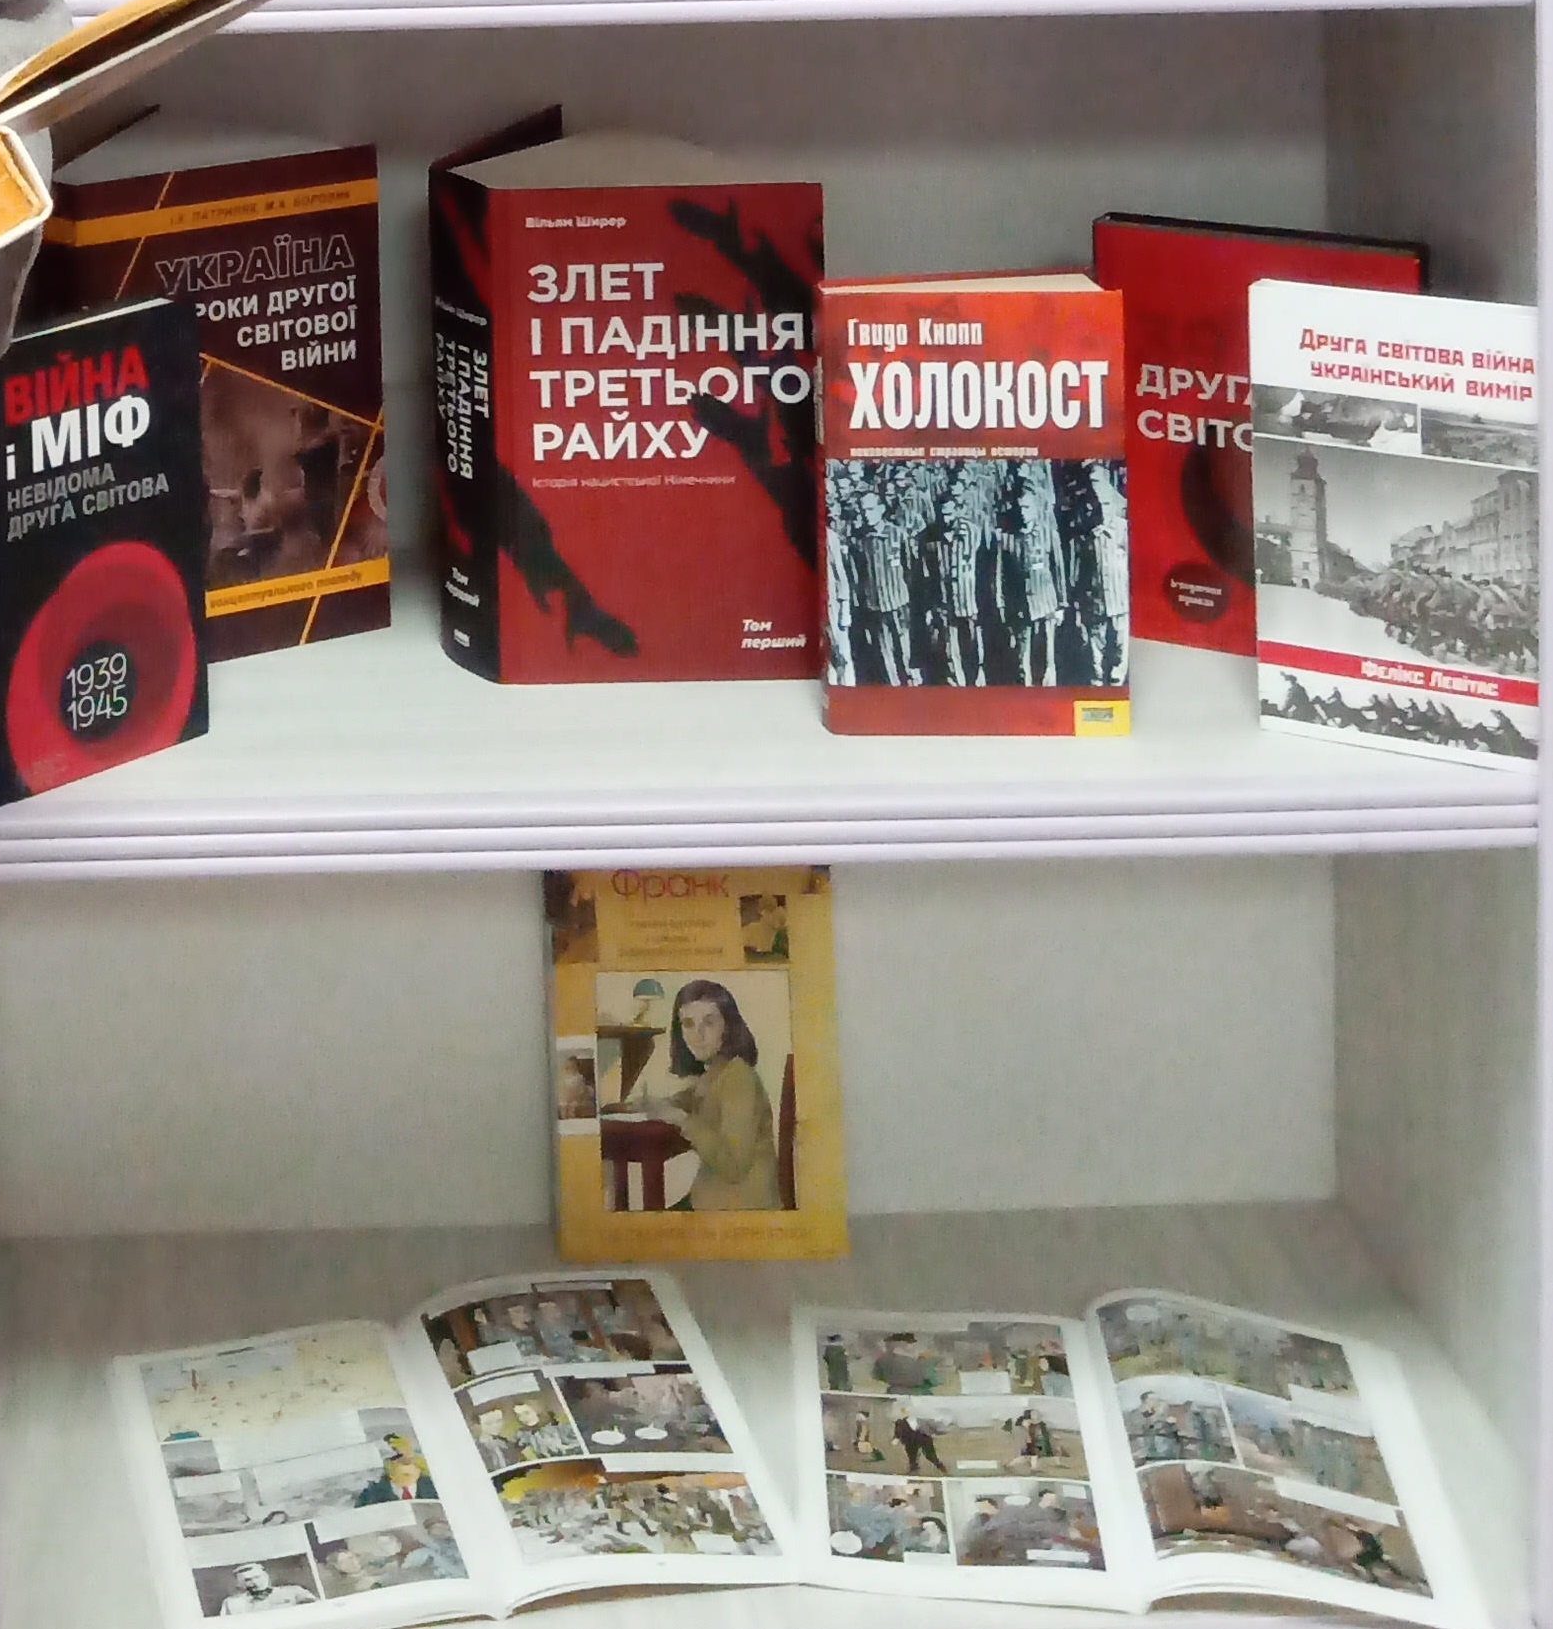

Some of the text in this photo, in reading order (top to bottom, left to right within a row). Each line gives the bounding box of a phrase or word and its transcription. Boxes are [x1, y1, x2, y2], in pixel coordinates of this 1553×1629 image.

[155, 233, 354, 295] УКРАЇНА
[527, 262, 664, 303] ЗЛЕТ
[267, 275, 356, 316] ДРУГОЇ
[237, 306, 357, 347] СВІТОВОЇ
[530, 312, 805, 360] І ПАДІННЯ
[848, 318, 983, 352] Гвидо Кнопп
[281, 340, 356, 371] ВІЙНИ
[4, 345, 149, 426] ВІЙНА
[473, 348, 489, 418] ЗЛЕТ
[529, 366, 811, 408] ТРЕТЬОГО
[848, 360, 1109, 430] ХОЛОКОСТ
[6, 394, 150, 481] і МІФ
[532, 412, 709, 461] РАЙХУ
[7, 463, 116, 512] НЕВІДОМА
[7, 473, 169, 542] ДРУГА СВІТОВА
[741, 634, 806, 650] перший
[743, 619, 772, 632] Том
[66, 652, 127, 698] 1939
[67, 684, 127, 731] 1945
